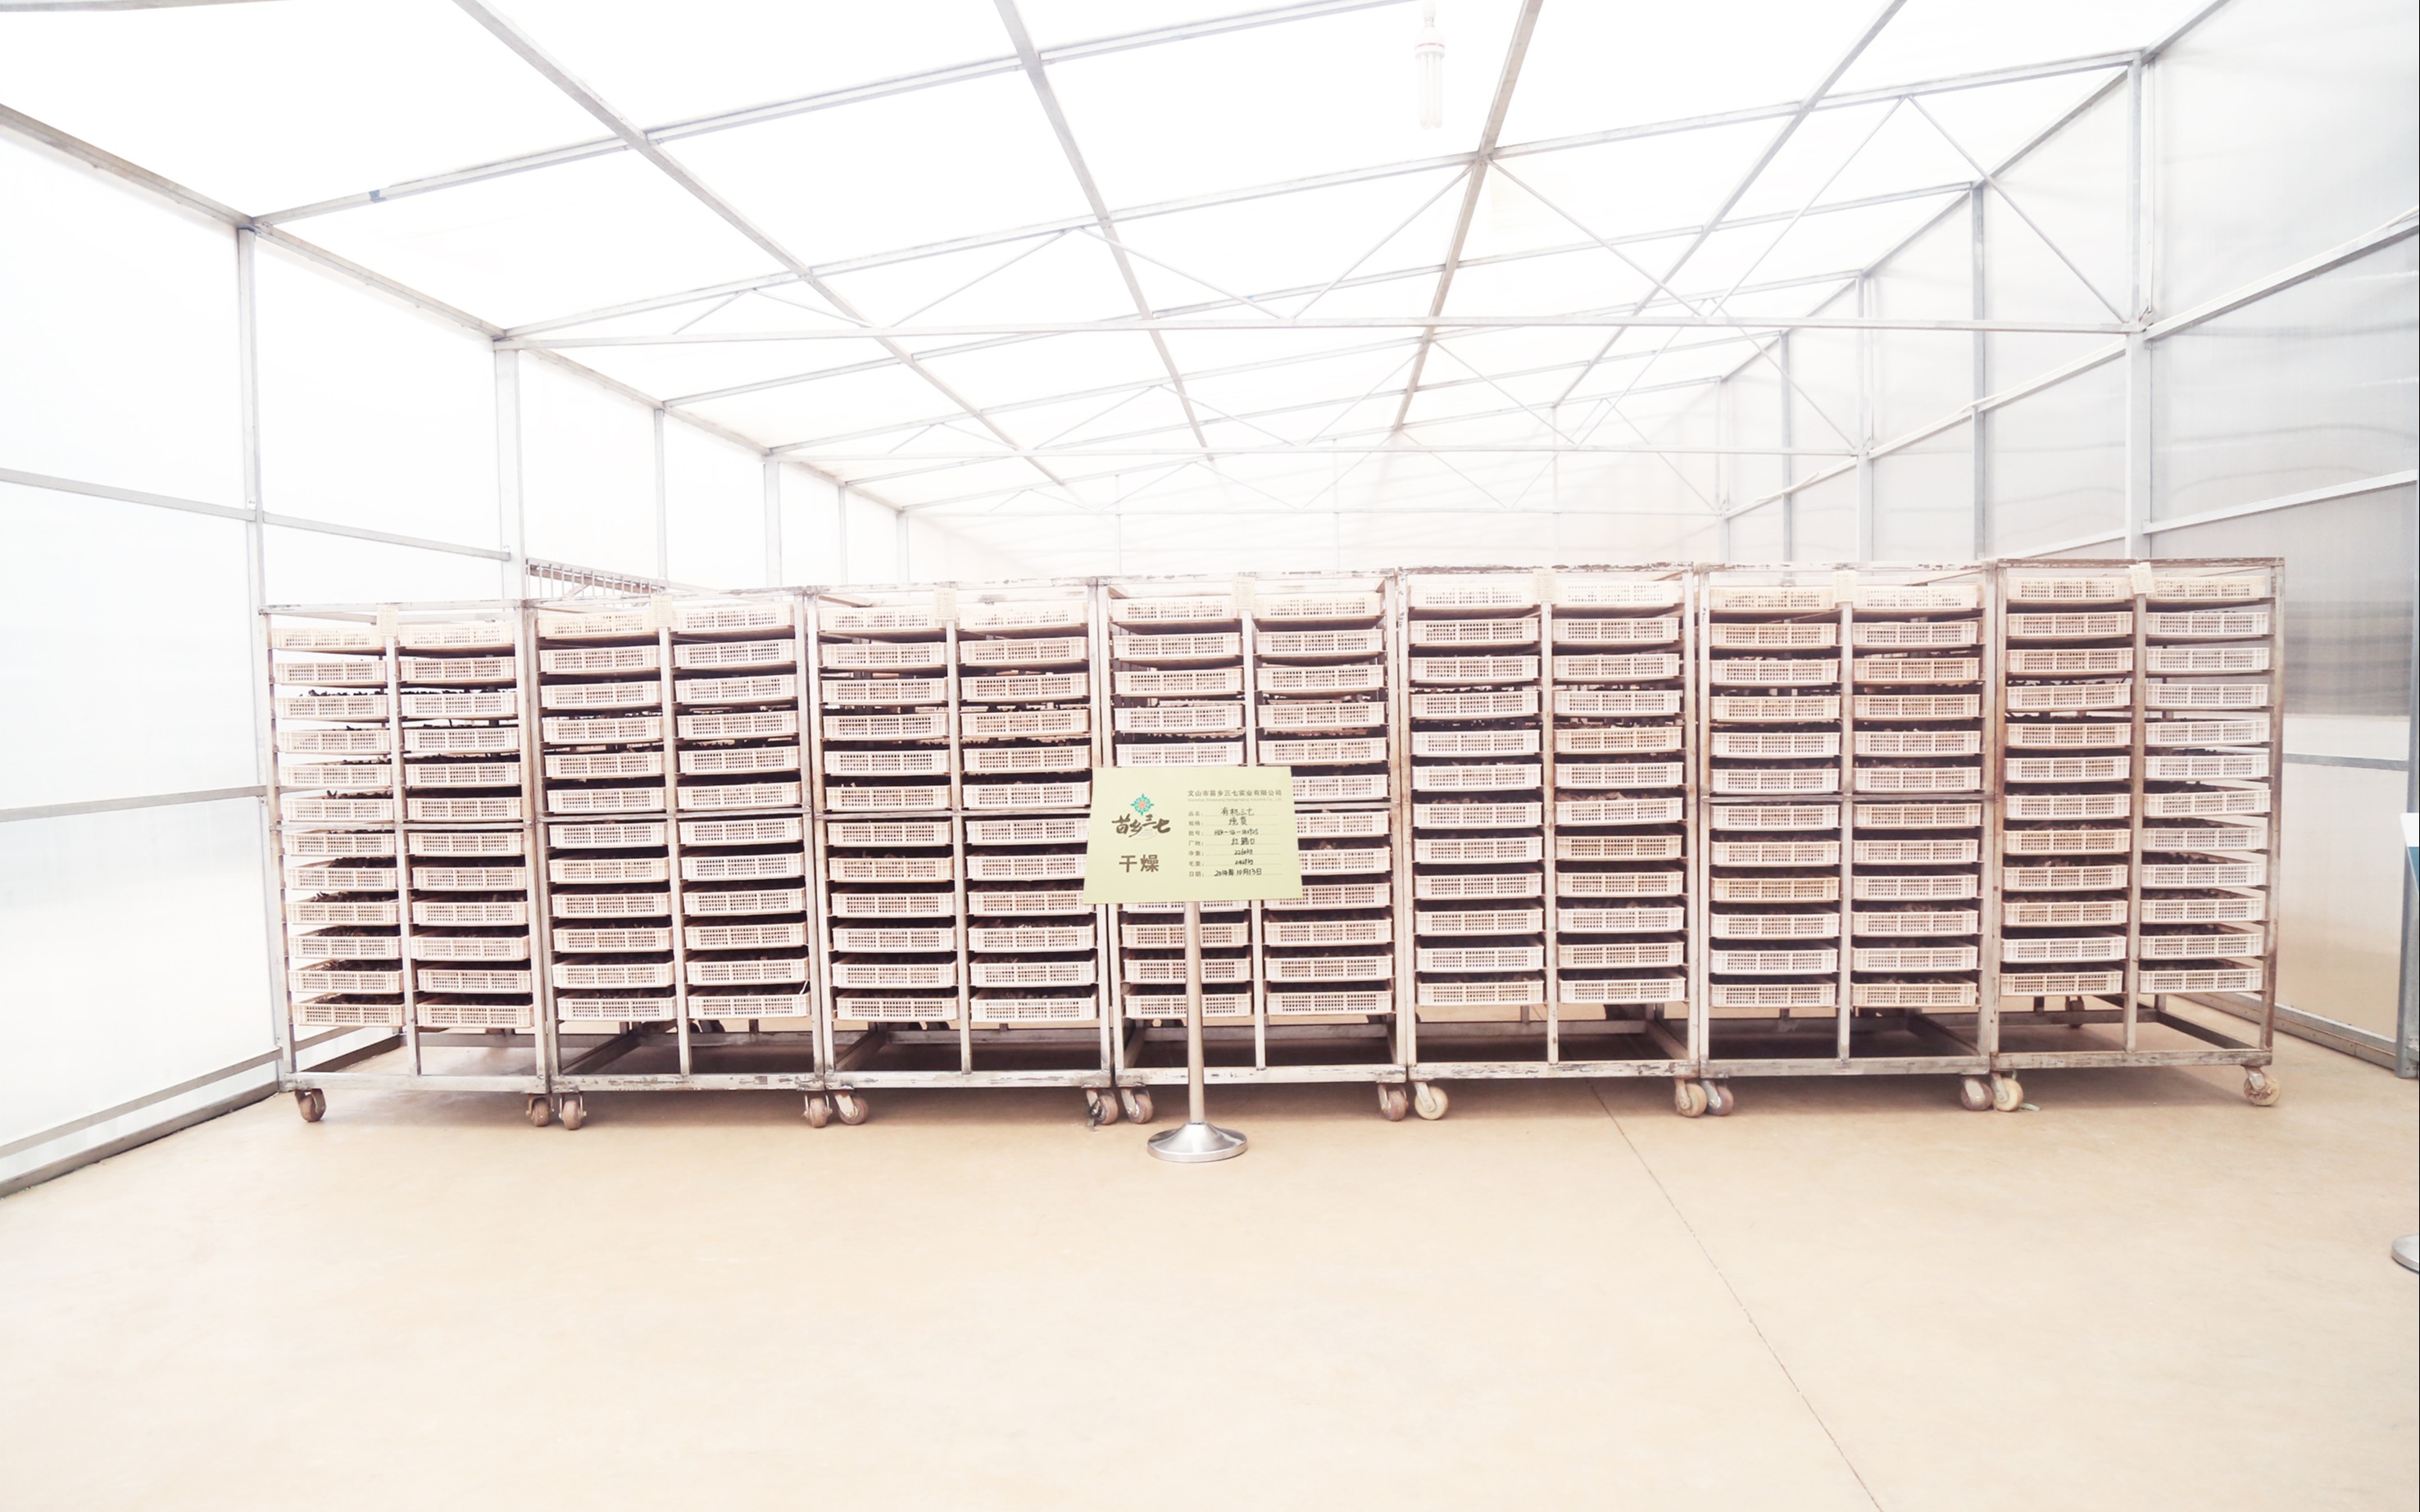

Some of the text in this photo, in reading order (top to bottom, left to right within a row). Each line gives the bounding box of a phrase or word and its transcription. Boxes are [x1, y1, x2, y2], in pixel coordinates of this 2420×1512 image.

[1111, 813, 1171, 838] 苗乡三七
[1119, 854, 1160, 873] 干燥
